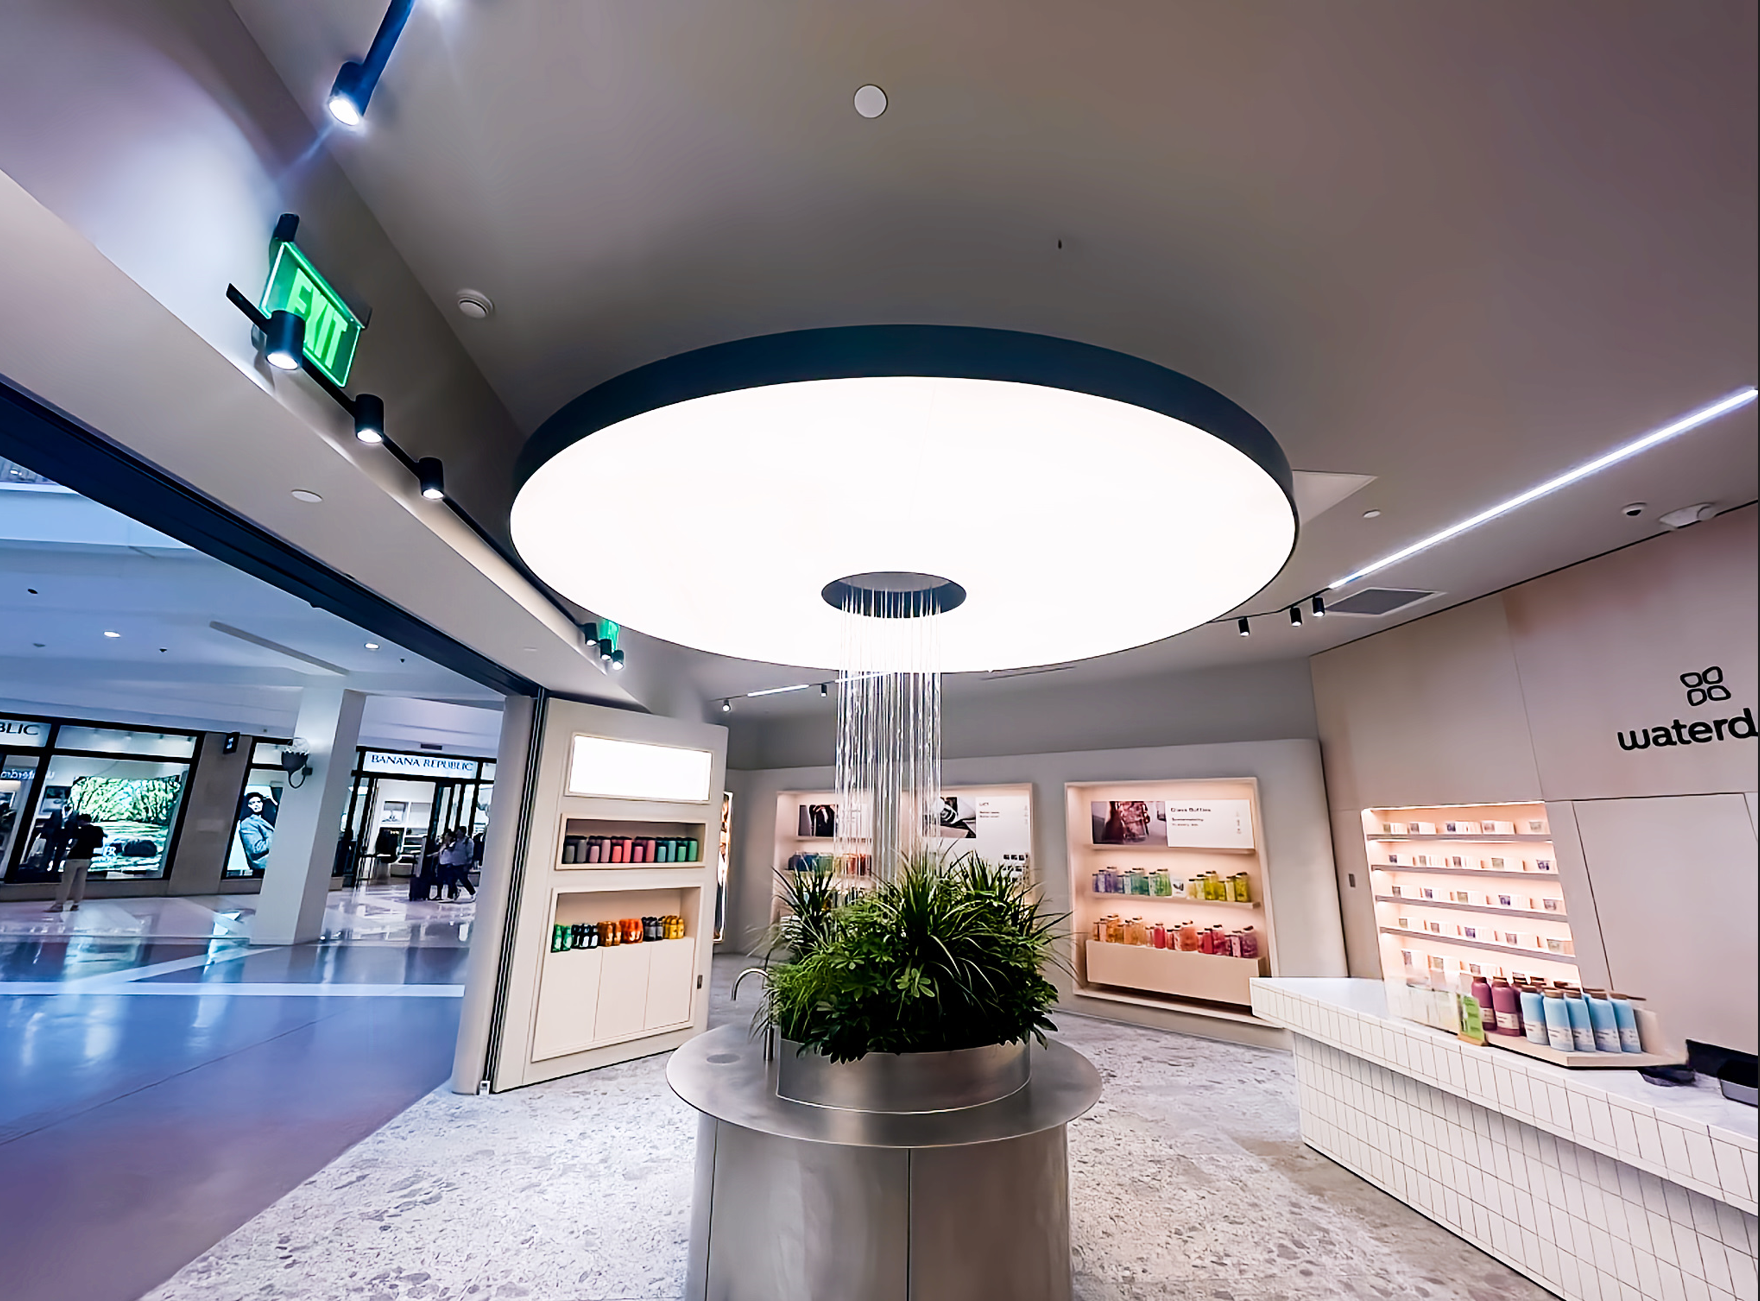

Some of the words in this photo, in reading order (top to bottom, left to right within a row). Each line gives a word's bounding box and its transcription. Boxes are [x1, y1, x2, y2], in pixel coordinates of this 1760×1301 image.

[285, 267, 349, 370] EXIT
[1617, 708, 1758, 751] waterd
[371, 754, 420, 767] BANANA
[423, 758, 474, 771] REPUBLIC
